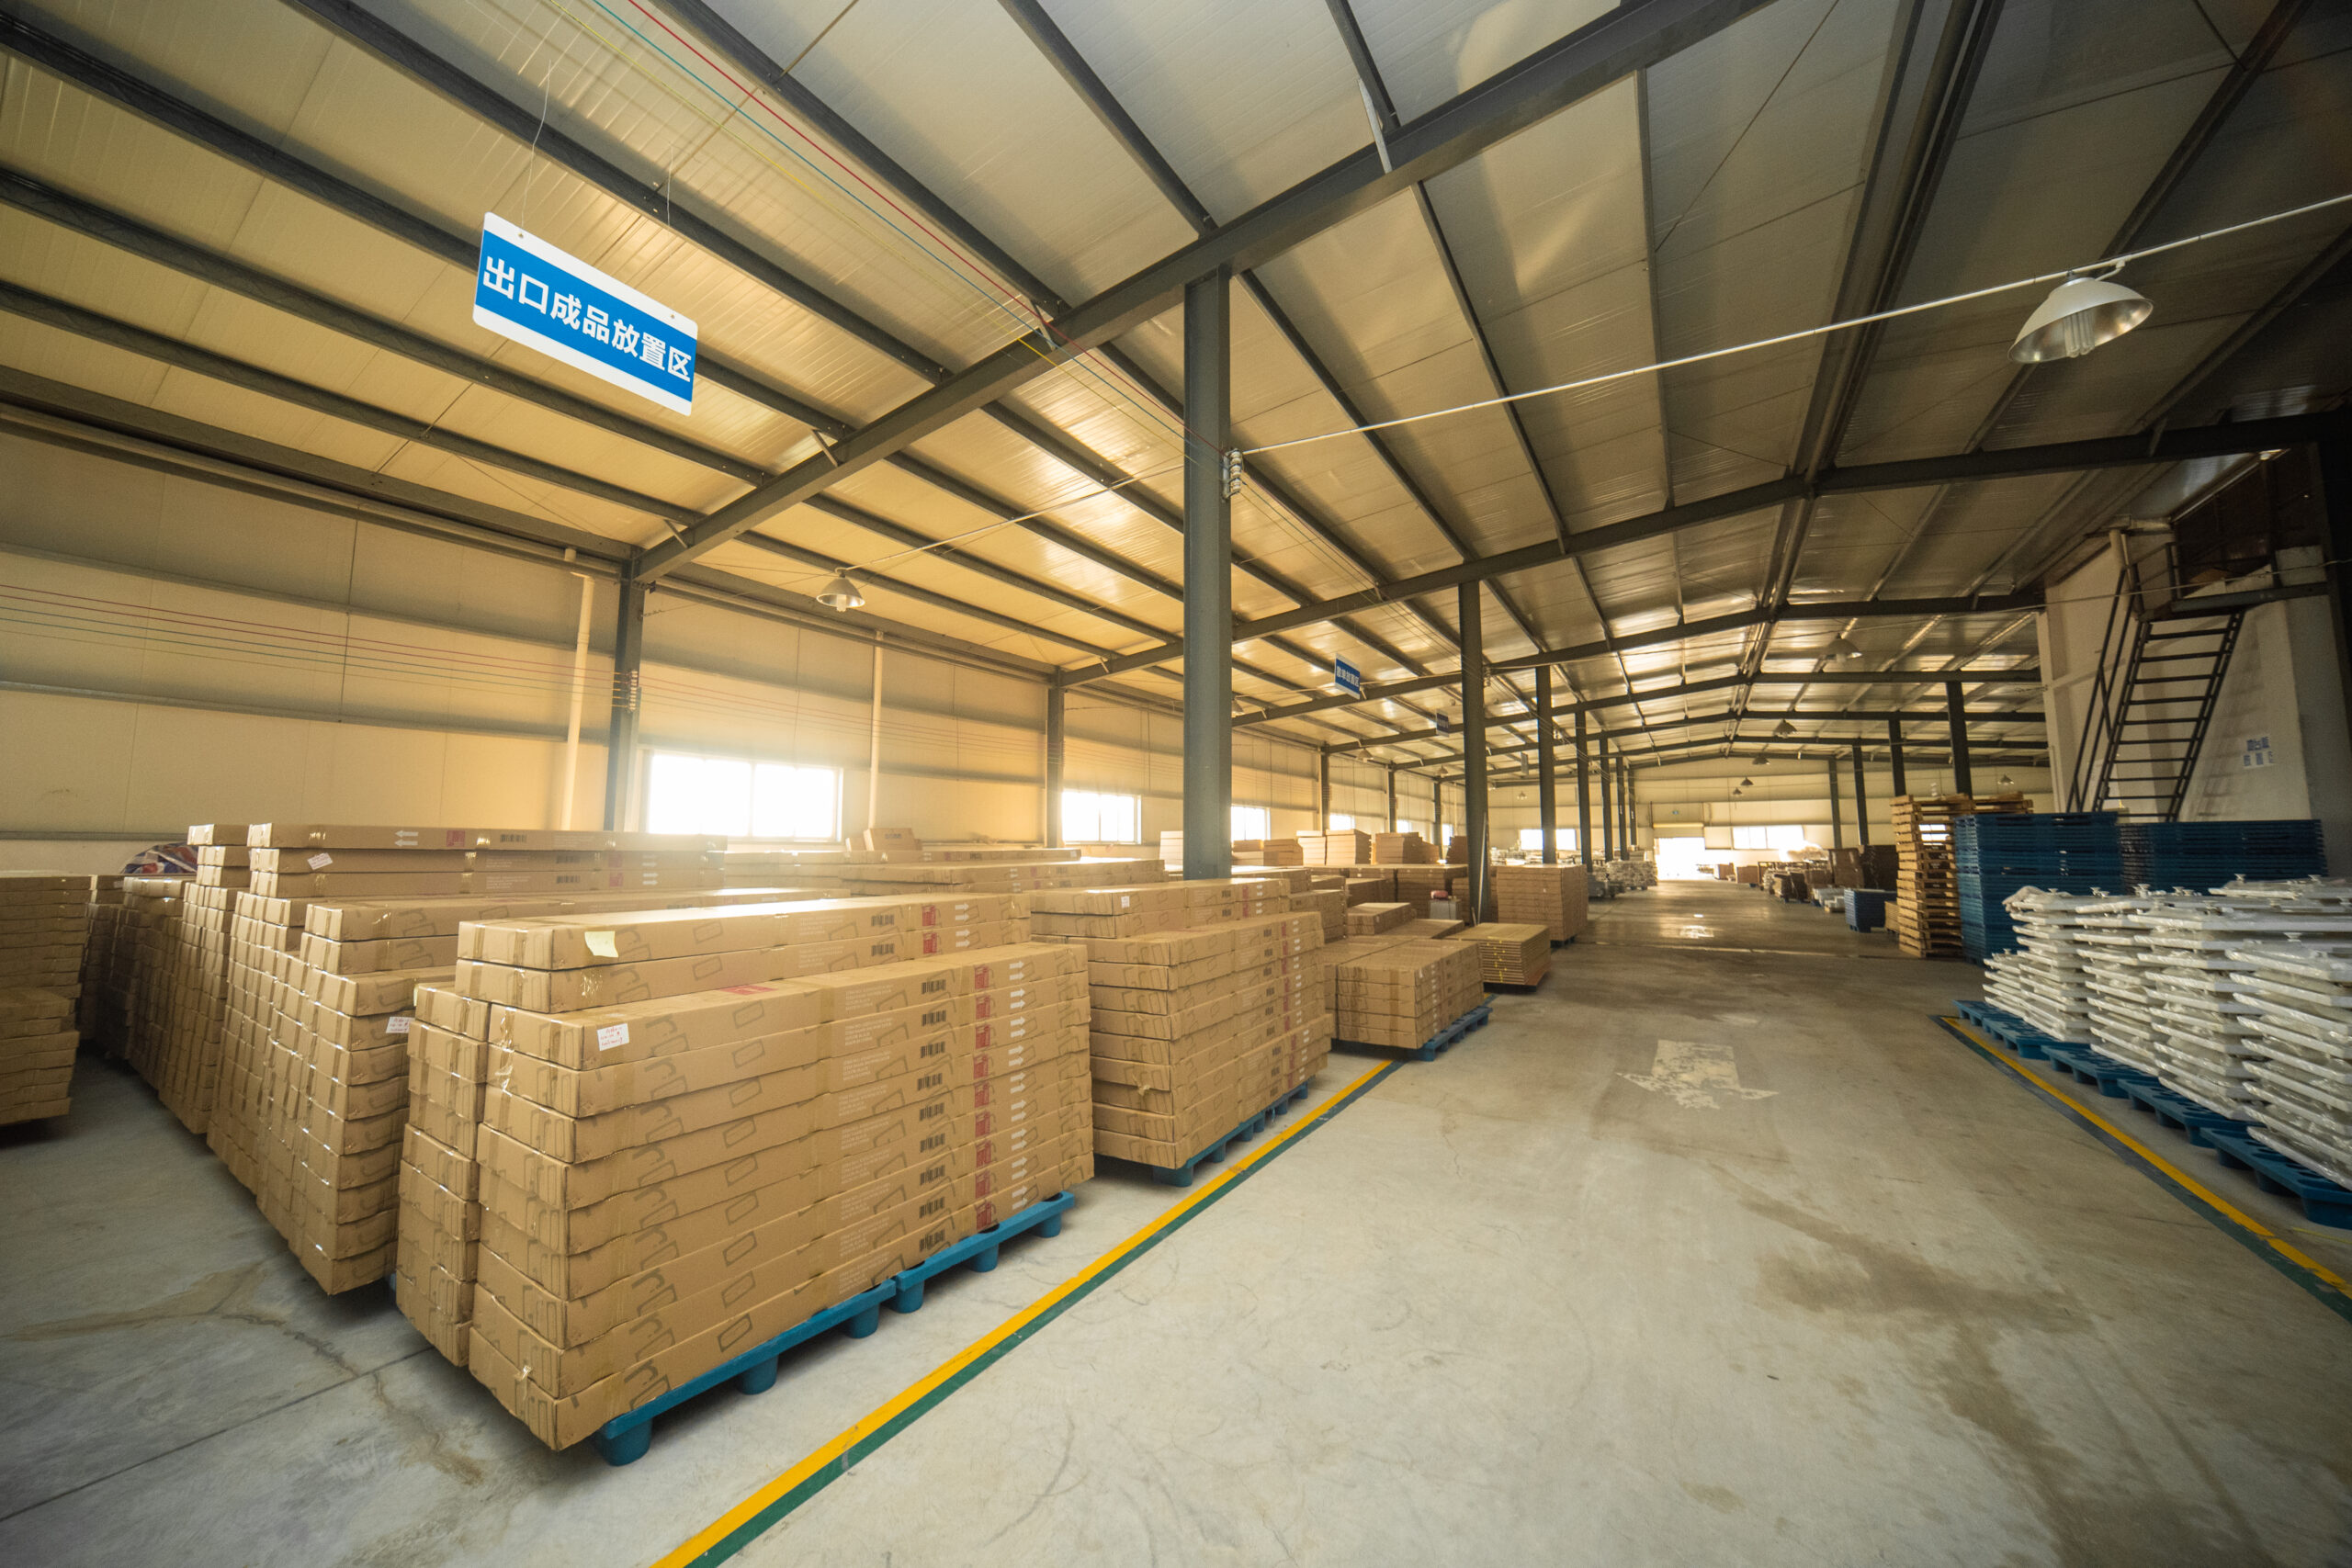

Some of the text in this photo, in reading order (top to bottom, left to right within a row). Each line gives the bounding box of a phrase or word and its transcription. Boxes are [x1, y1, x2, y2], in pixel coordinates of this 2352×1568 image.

[483, 256, 691, 382] 出口成品放置区
